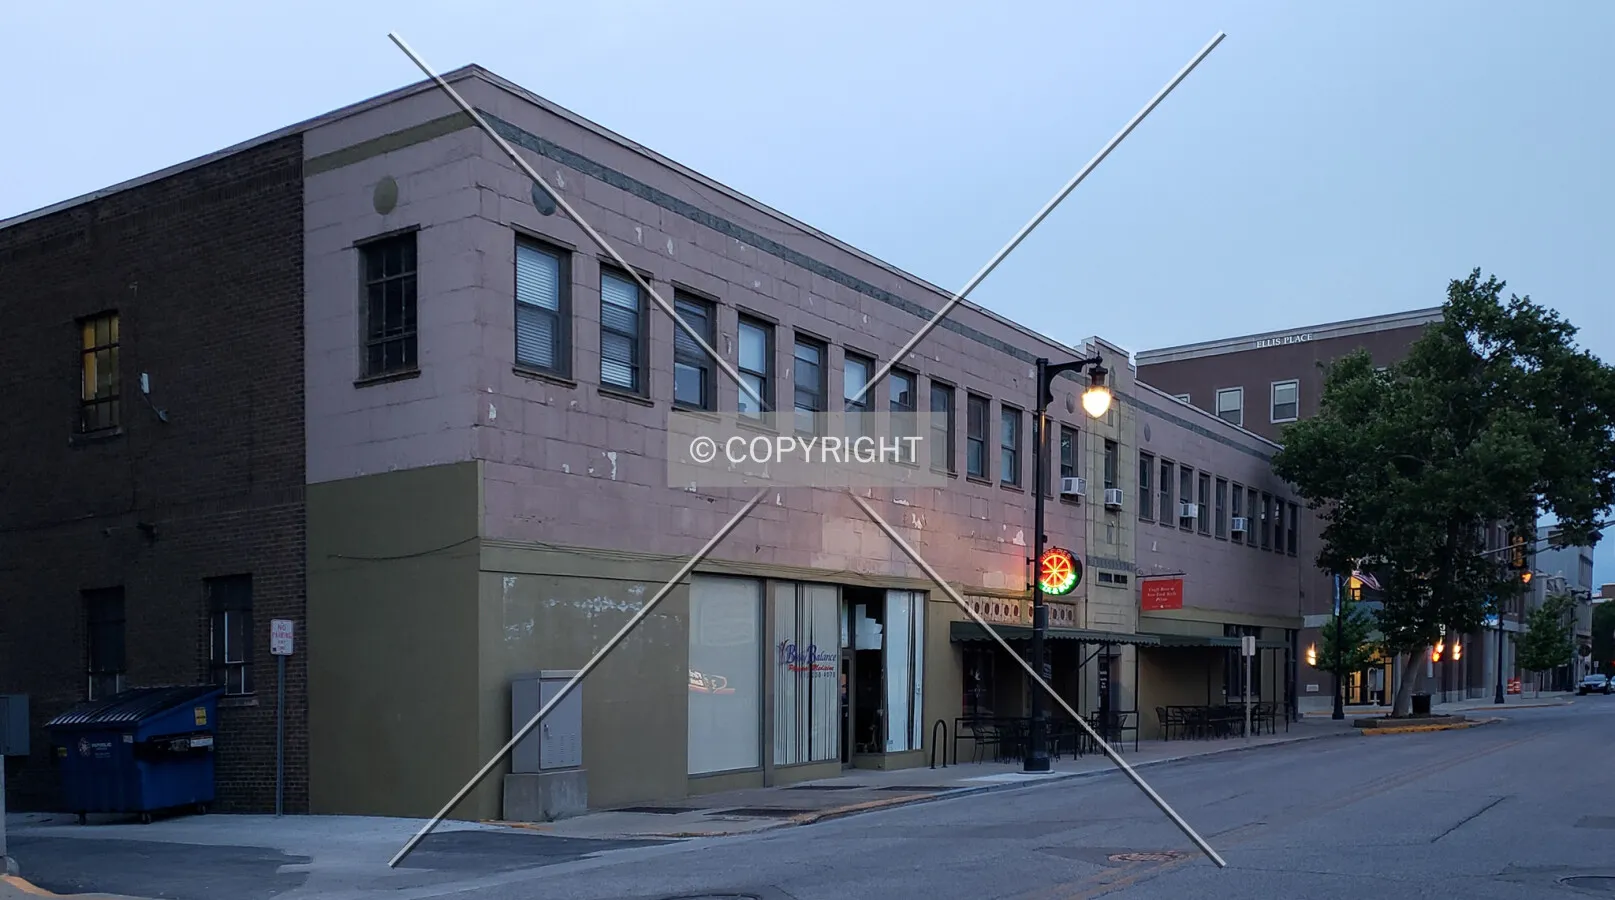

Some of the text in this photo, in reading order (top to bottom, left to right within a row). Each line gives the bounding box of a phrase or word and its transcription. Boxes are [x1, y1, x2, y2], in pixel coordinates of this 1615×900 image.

[1256, 333, 1313, 348] ELLIS PLACE
[278, 623, 287, 631] NO
[806, 645, 836, 664] Balance
